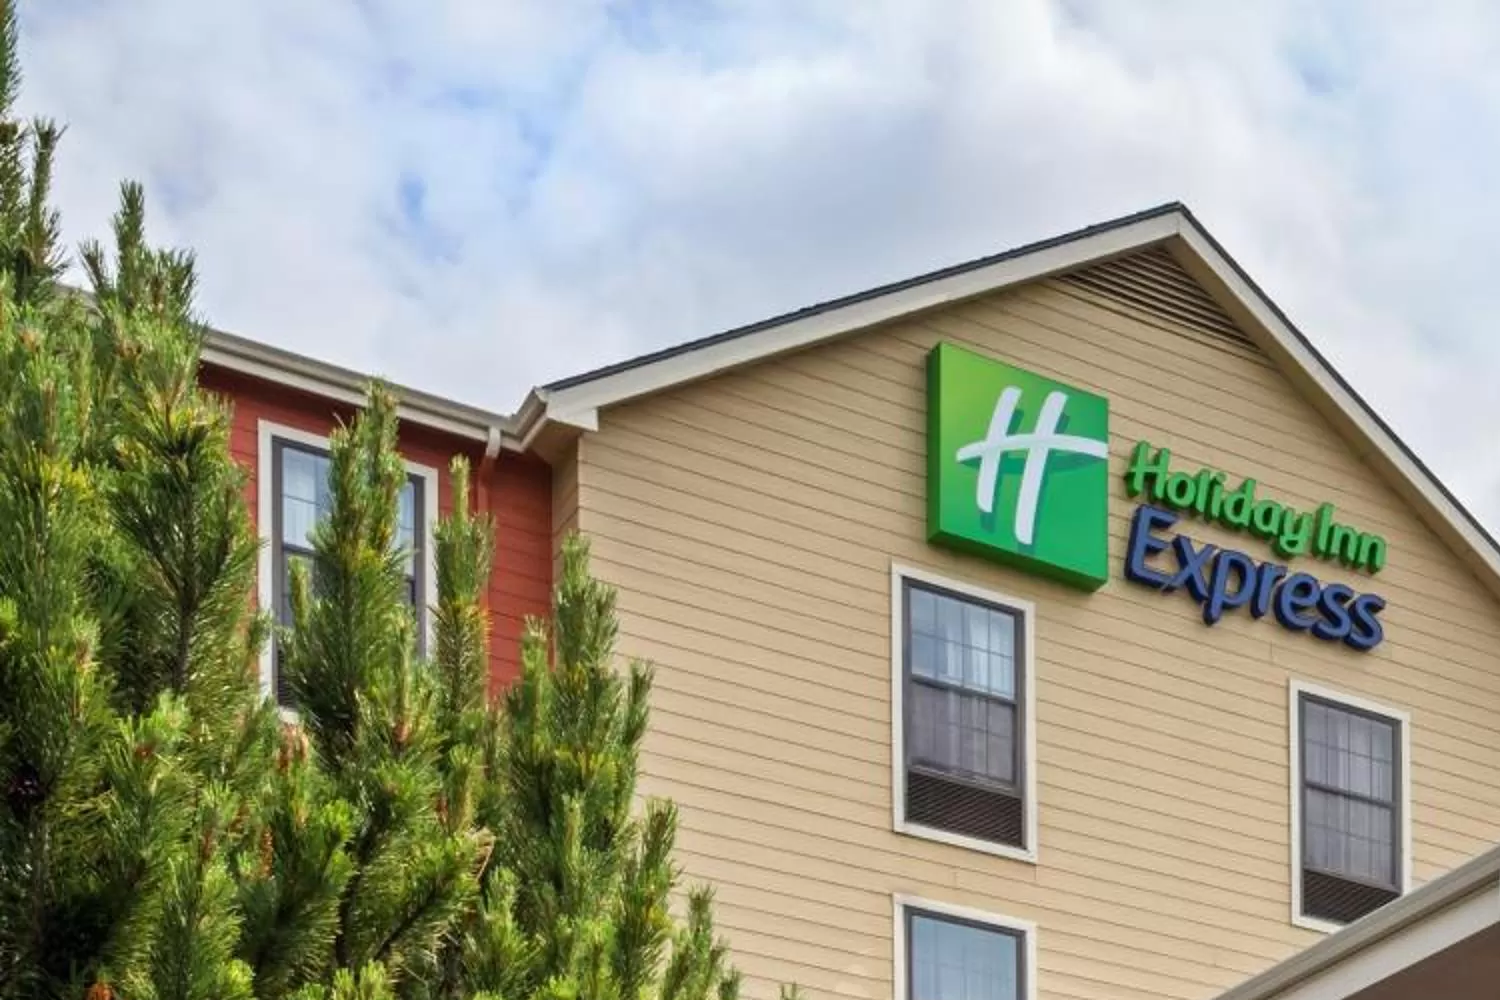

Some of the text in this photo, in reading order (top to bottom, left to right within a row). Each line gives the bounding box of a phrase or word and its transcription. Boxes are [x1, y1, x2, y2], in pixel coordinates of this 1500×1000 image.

[1124, 439, 1387, 574] Holiday Inn
[1124, 503, 1387, 651] Express
